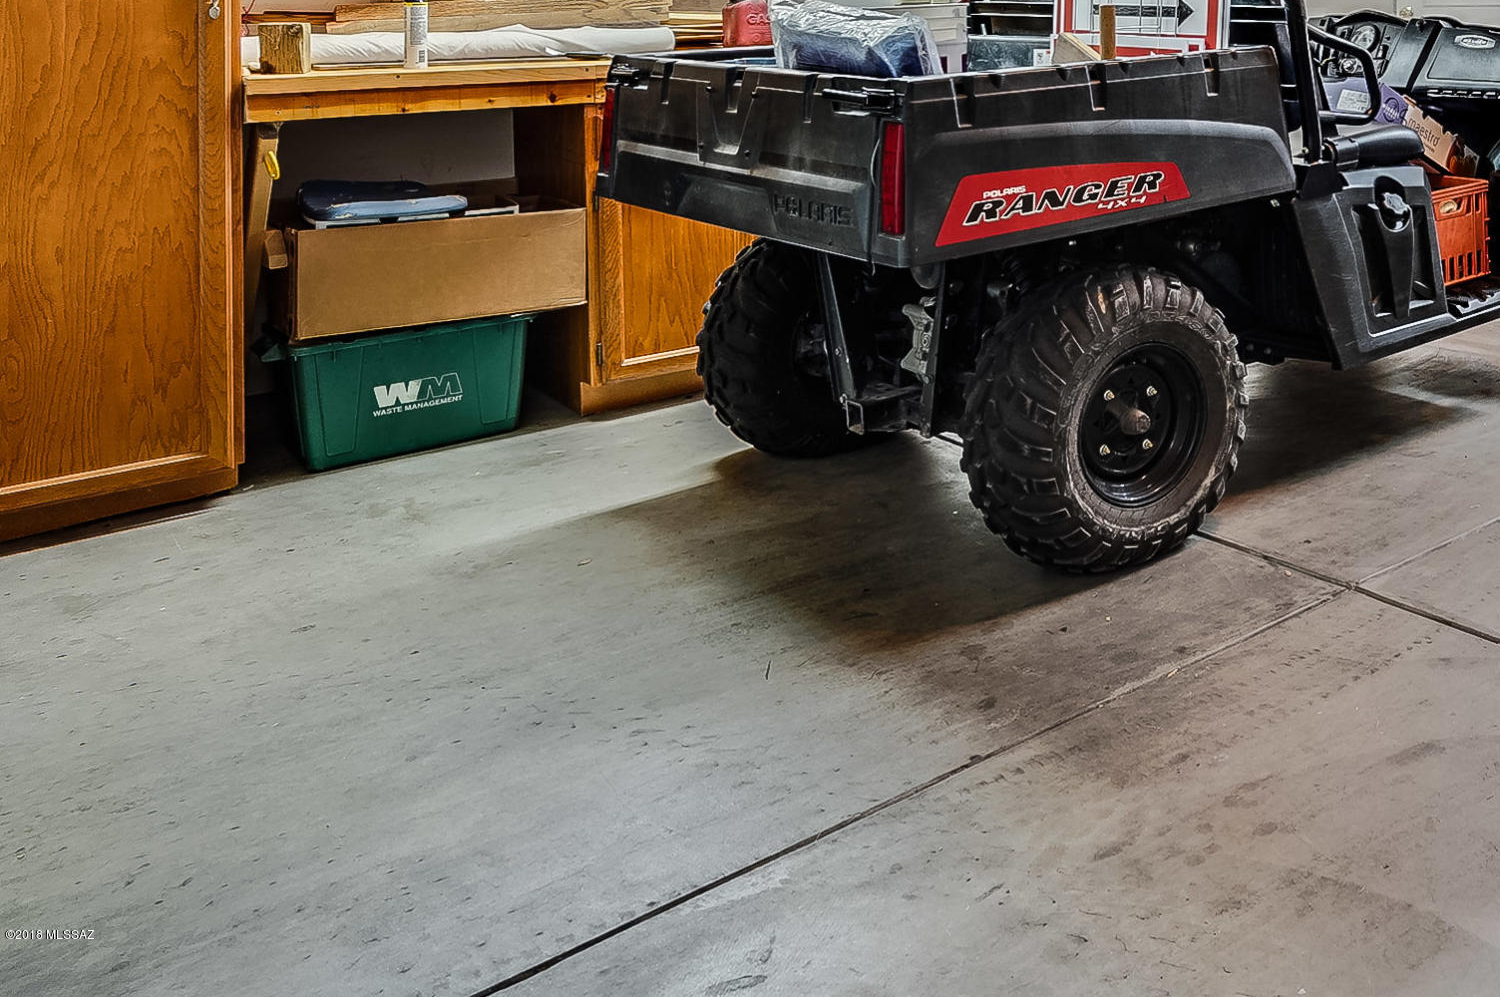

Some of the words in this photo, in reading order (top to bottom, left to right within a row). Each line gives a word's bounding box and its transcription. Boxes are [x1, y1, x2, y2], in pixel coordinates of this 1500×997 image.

[962, 171, 1165, 226] RANGER
[983, 185, 1026, 199] POLARIS
[373, 372, 463, 408] WM
[373, 406, 403, 417] WASTE
[404, 394, 463, 411] MANAGEMENT
